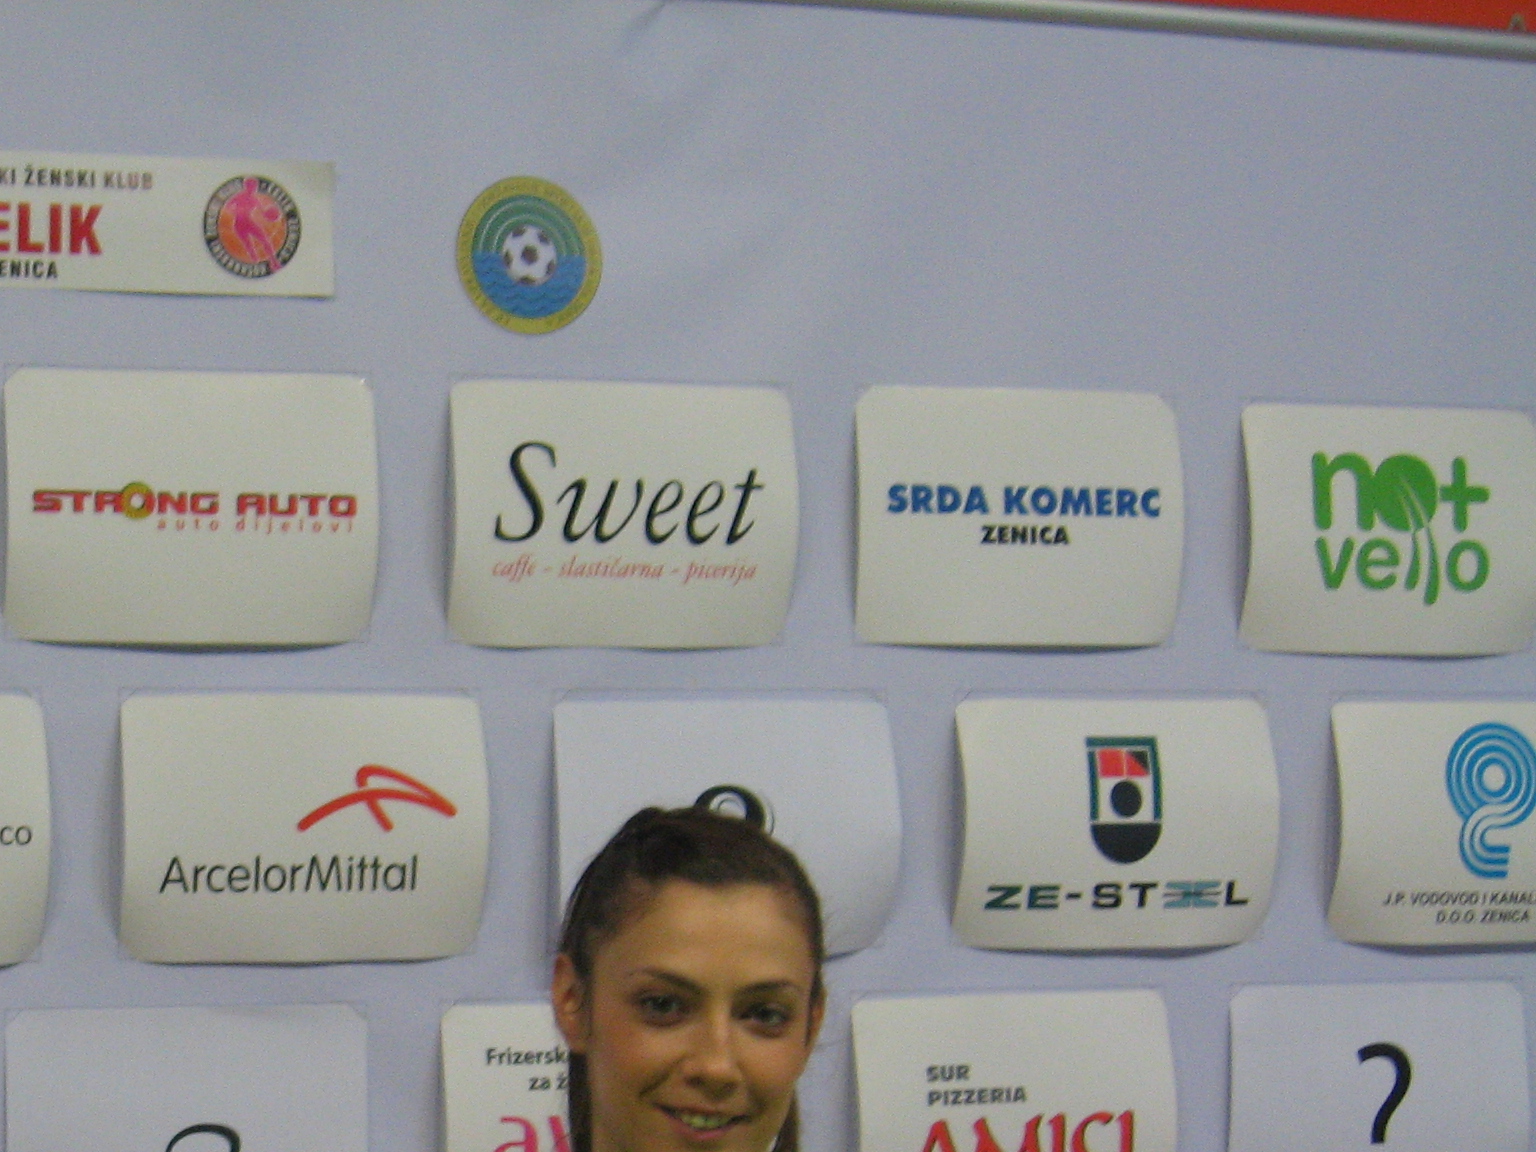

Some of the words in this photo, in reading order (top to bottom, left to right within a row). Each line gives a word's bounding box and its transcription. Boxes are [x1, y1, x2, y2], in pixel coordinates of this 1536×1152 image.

[23, 163, 97, 188] ŽENSKI
[103, 170, 154, 190] KLUB
[32, 481, 220, 520] STRONG
[236, 491, 358, 517] AUTO
[493, 440, 766, 546] Sweet
[887, 484, 989, 515] SRDA
[1002, 485, 1161, 518] KOMERC
[158, 517, 219, 532] auto
[236, 518, 354, 534] dijelovi
[980, 525, 1070, 545] ZENICA
[160, 854, 418, 894] ArcelorMittal
[1480, 909, 1530, 923] ZENICA
[927, 1065, 970, 1083] SUR
[927, 1086, 1028, 1107] PIZZERIA
